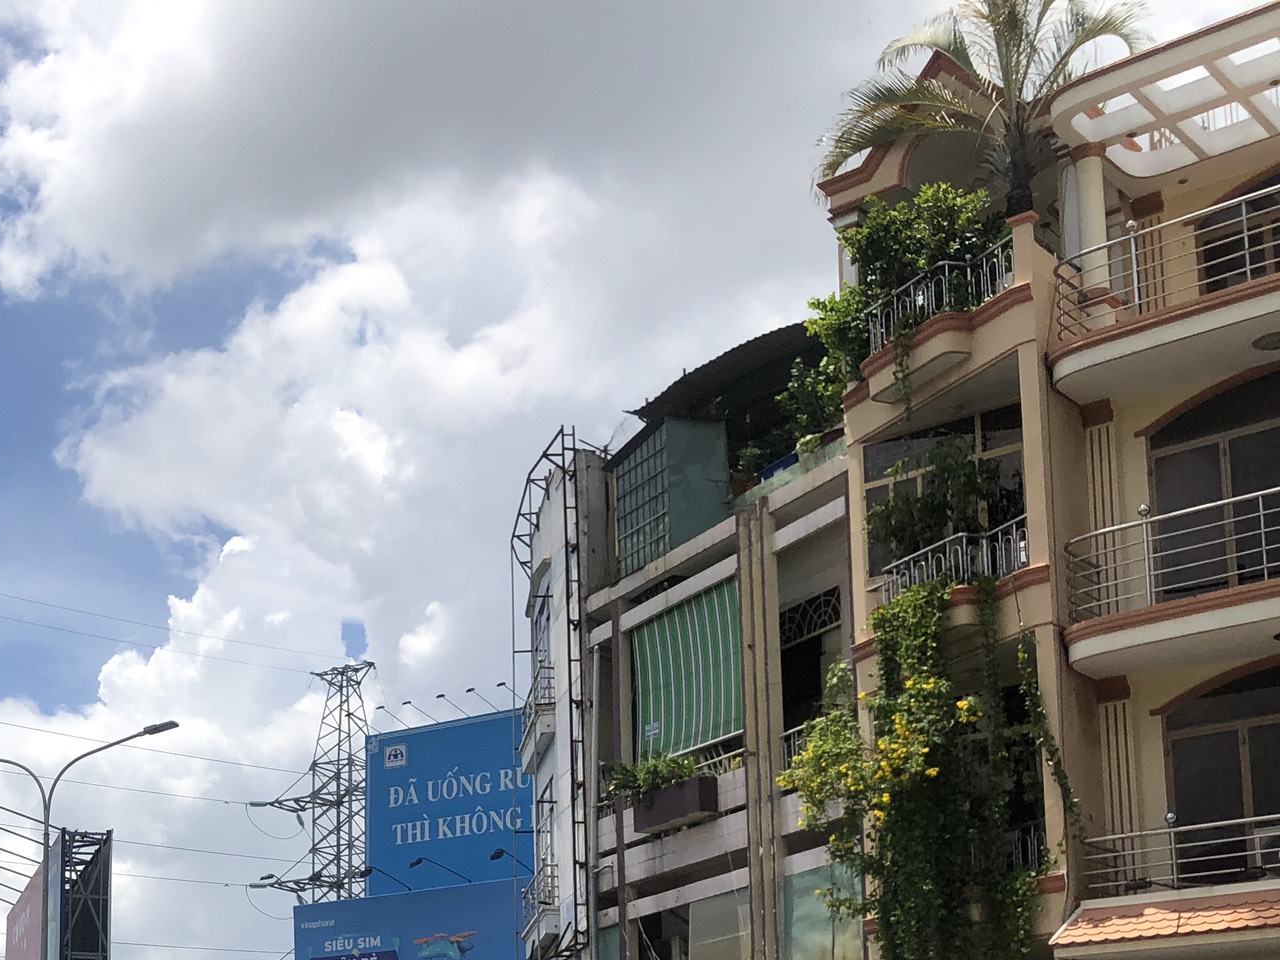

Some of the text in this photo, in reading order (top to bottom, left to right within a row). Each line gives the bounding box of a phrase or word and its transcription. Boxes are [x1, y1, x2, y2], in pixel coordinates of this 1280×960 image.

[388, 777, 419, 808] ĐÃ
[426, 766, 493, 802] UỐNG
[392, 813, 431, 845] THÌ
[437, 805, 523, 839] KHÔNG
[324, 935, 381, 952] SIÊU SIM
